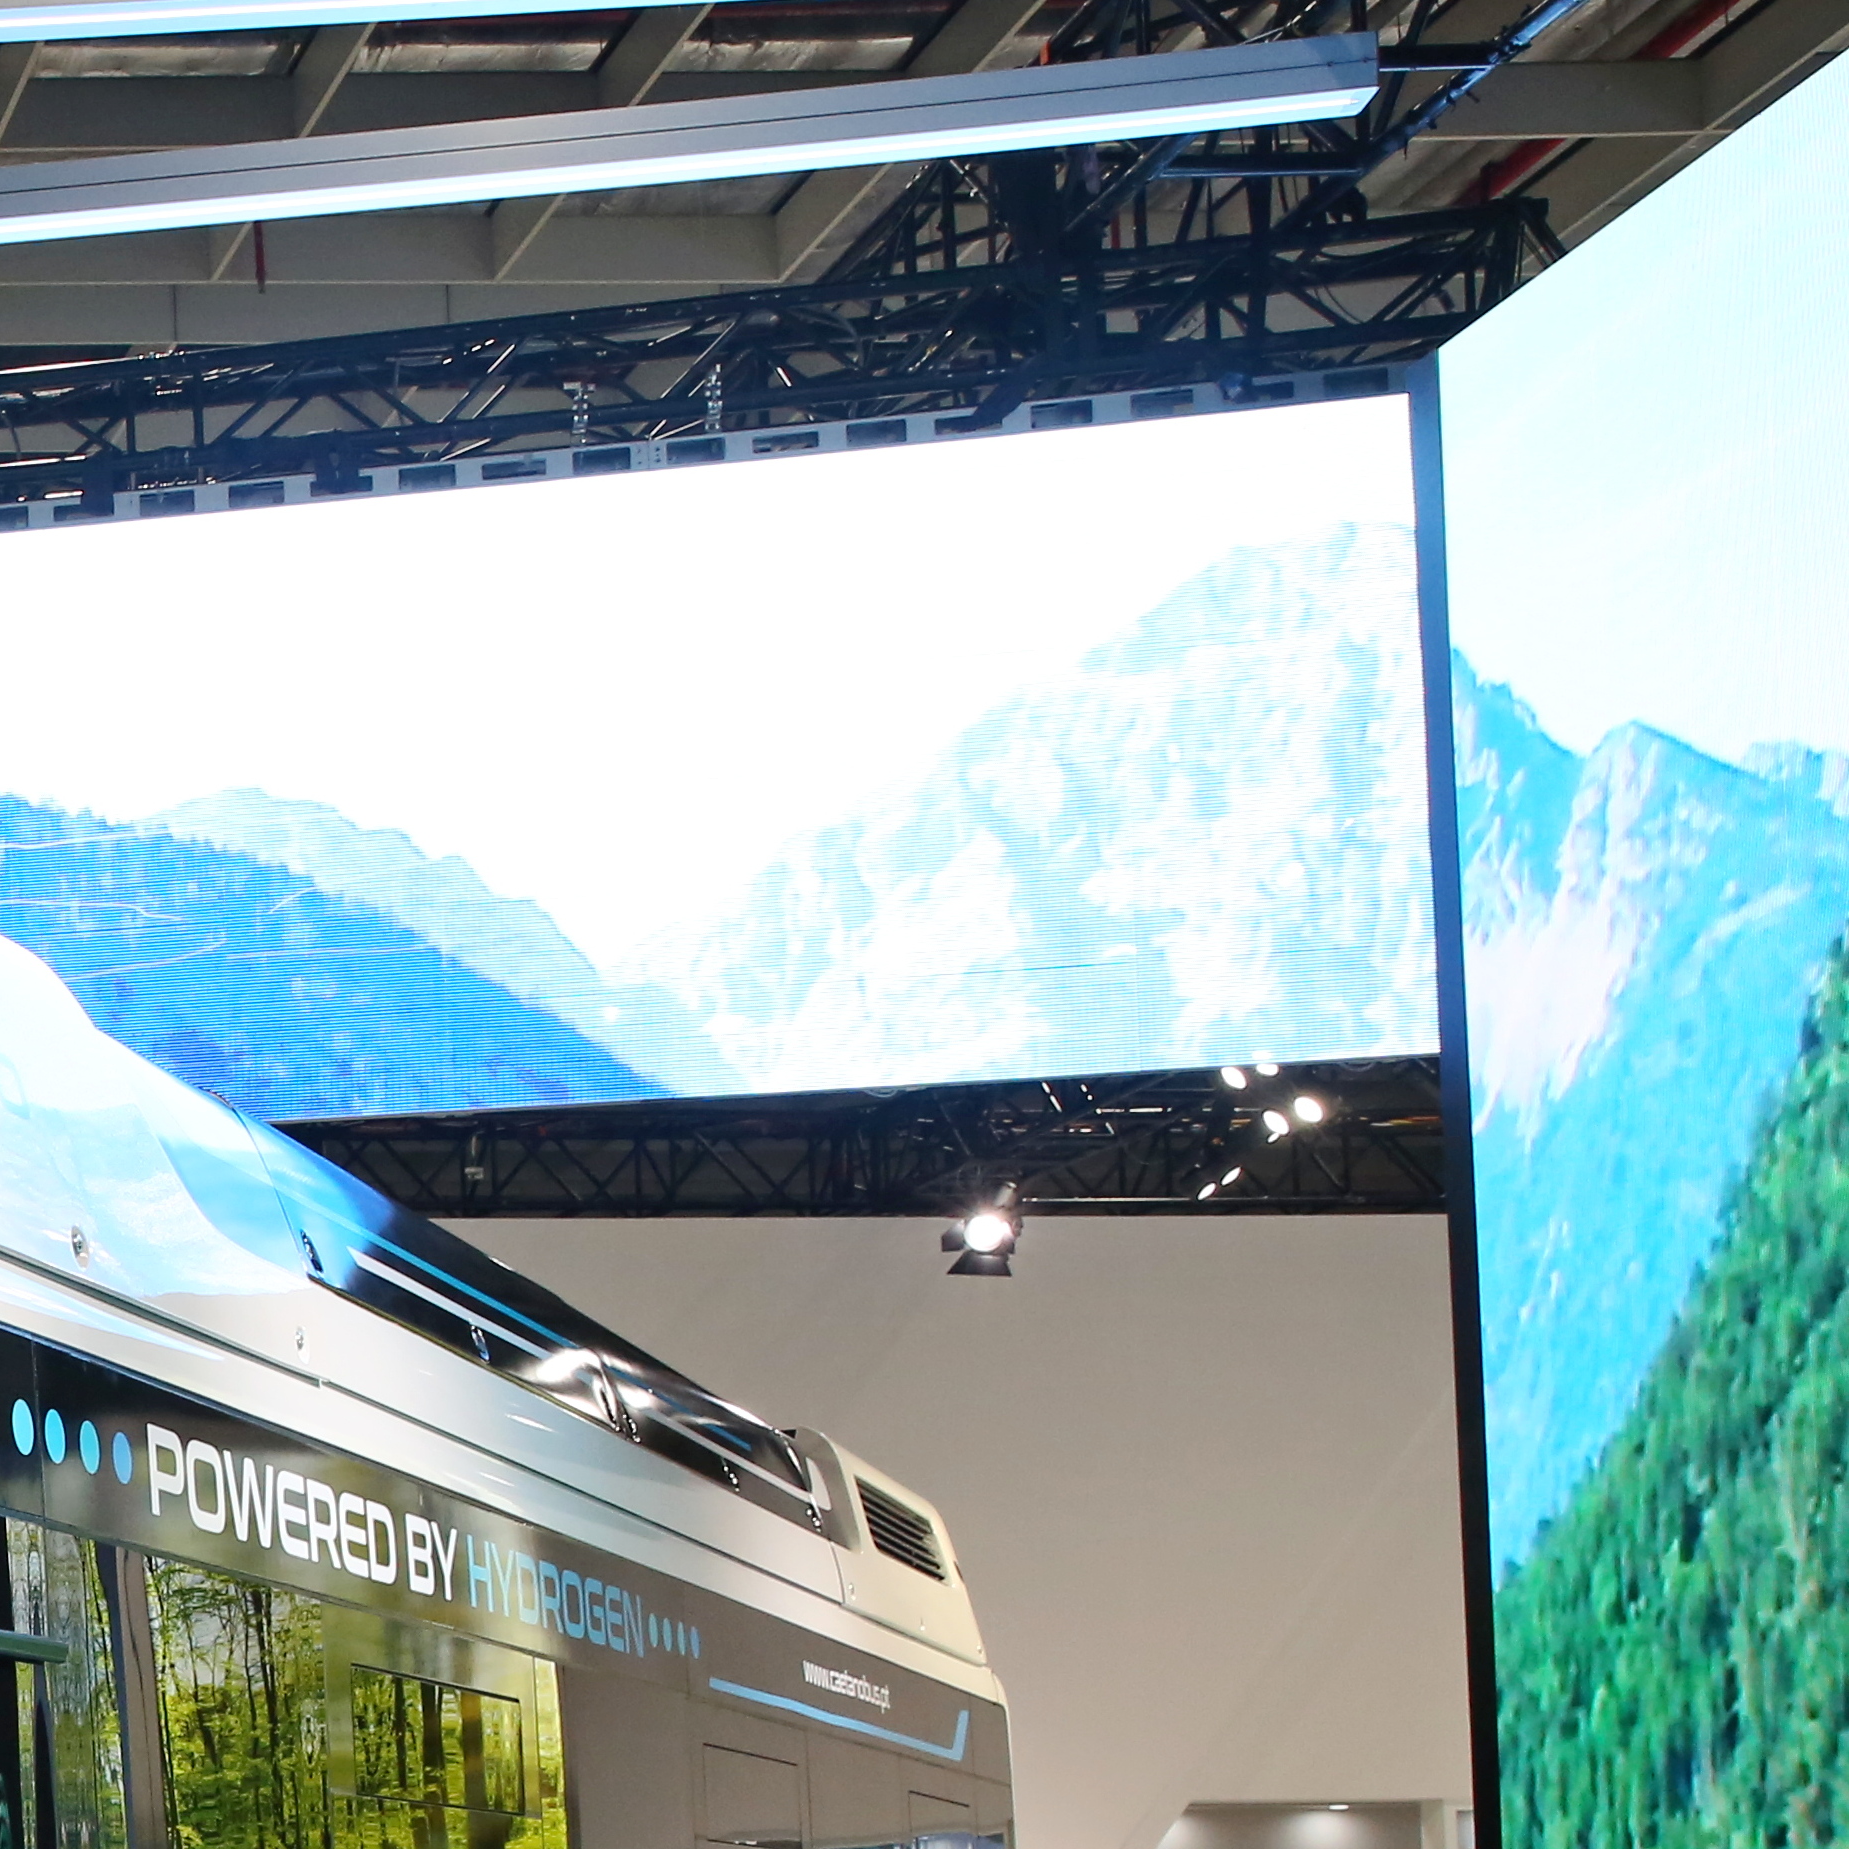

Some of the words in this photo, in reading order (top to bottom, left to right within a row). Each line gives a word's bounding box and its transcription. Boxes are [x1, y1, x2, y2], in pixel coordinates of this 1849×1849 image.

[145, 1422, 399, 1585] POWERED
[405, 1517, 457, 1601] BY
[466, 1533, 644, 1658] HYDROGEN
